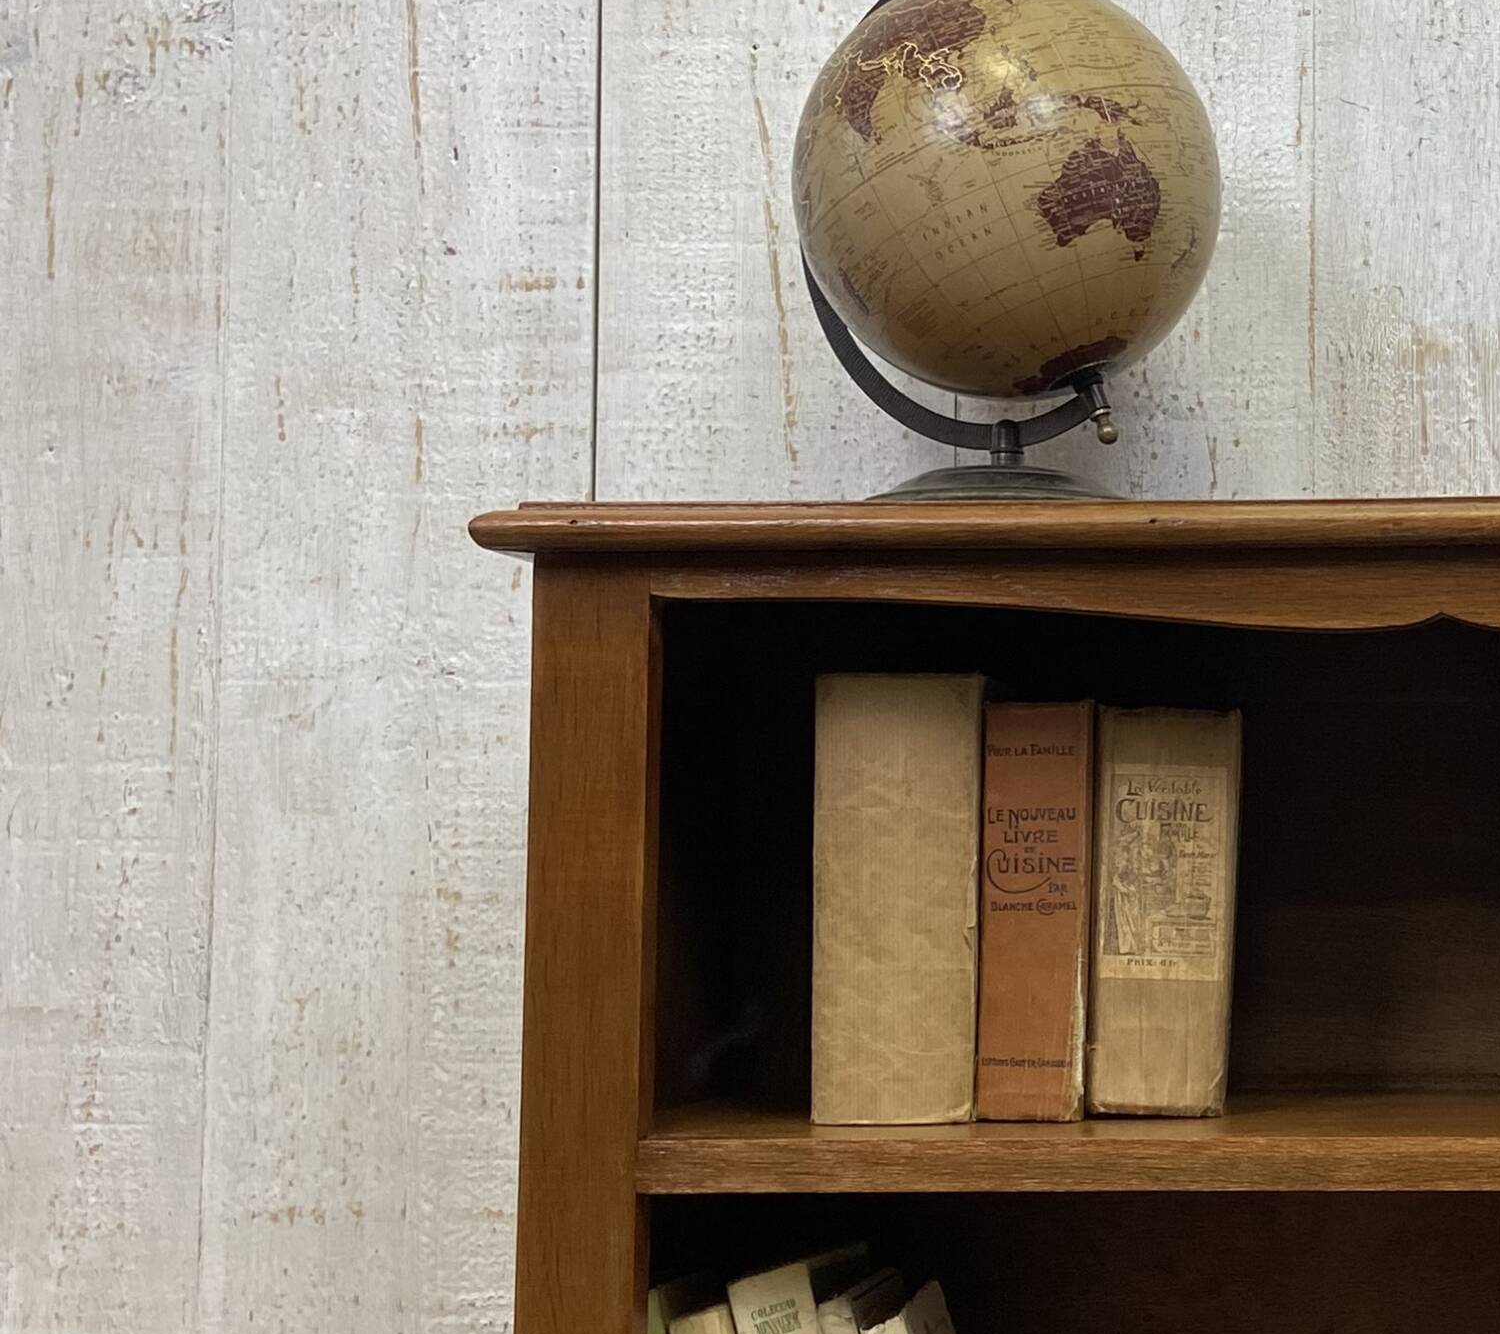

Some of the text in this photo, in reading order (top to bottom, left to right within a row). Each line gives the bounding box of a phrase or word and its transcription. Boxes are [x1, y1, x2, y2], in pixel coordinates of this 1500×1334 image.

[923, 202, 988, 242] INDIAN
[936, 227, 992, 260] OCEAN
[1029, 744, 1075, 756] FAMILLE
[987, 807, 1077, 829] LE NOUVEAU
[1115, 798, 1213, 823] CUISINE
[1003, 827, 1059, 844] LIVRE
[987, 849, 1077, 894] CUISINE
[991, 901, 1033, 912] BLANCHE
